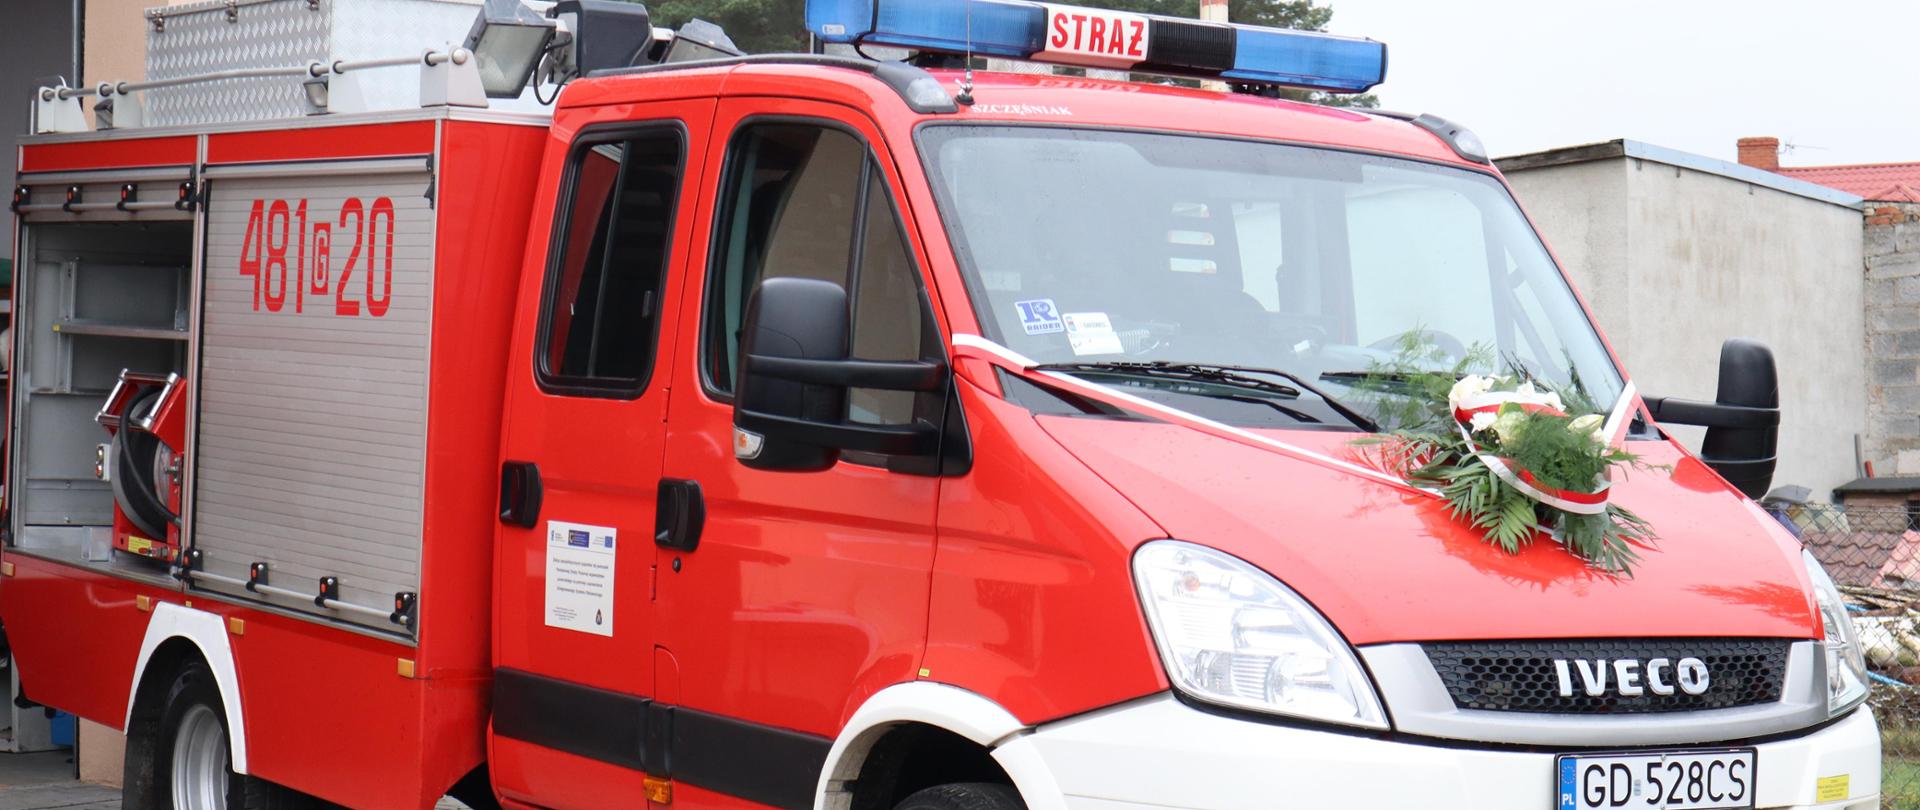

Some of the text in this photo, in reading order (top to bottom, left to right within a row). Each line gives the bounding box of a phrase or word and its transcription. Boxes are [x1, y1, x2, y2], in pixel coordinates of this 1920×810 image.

[1554, 657, 1710, 697] IVECO
[1562, 793, 1575, 806] PL
[1583, 759, 1746, 808] GD 528CS
